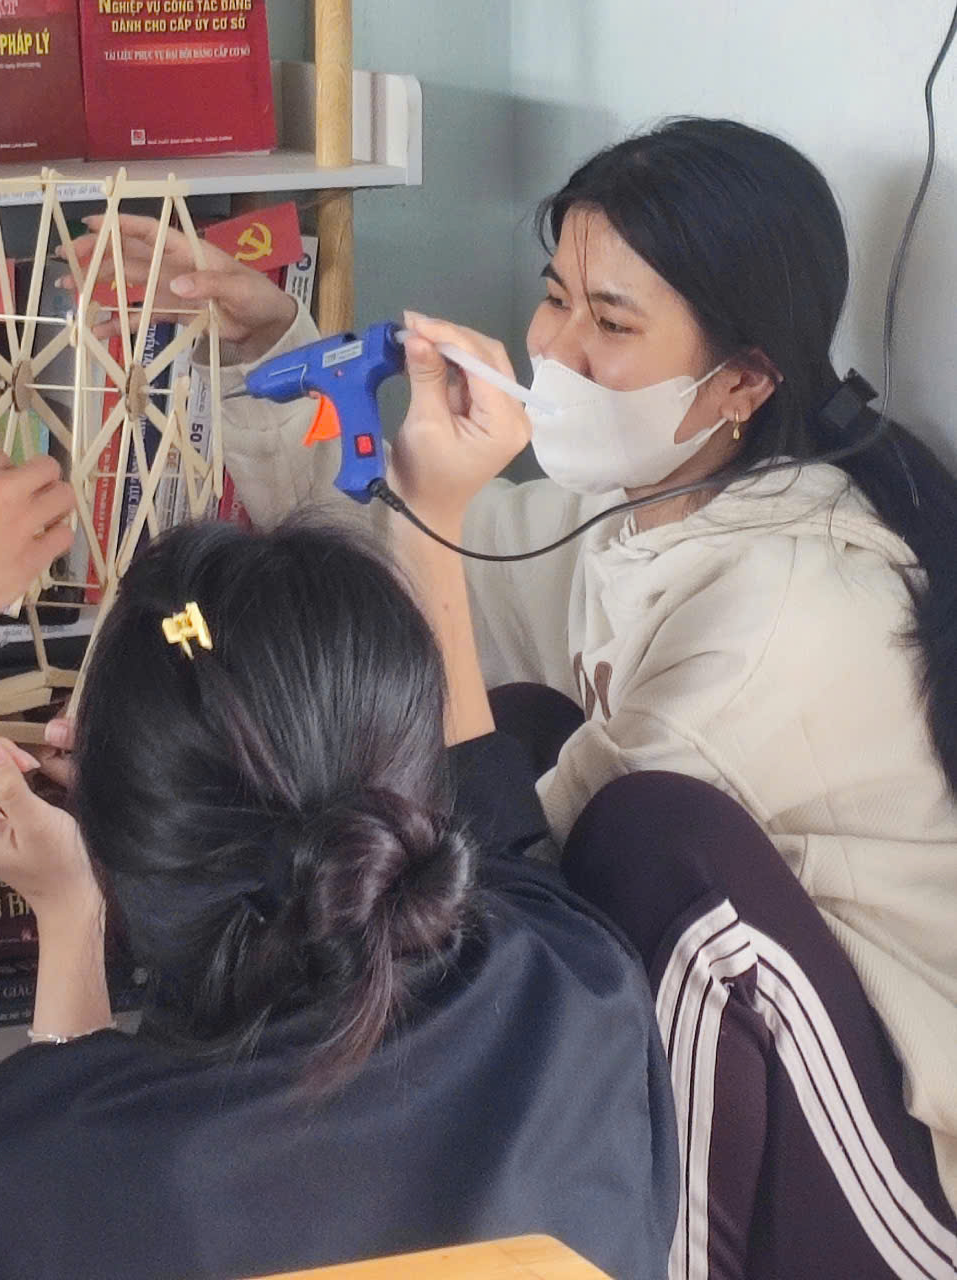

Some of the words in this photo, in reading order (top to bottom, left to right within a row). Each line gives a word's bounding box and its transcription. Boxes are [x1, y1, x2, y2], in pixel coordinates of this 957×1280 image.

[146, 0, 161, 16] VỤ
[111, 18, 142, 33] DÀNH
[144, 18, 167, 33] CHO
[169, 14, 192, 32] CẤP
[212, 16, 228, 31] CƠ
[0, 27, 33, 56] PHÁP
[35, 26, 50, 56] LÝ
[189, 422, 203, 443] 50
